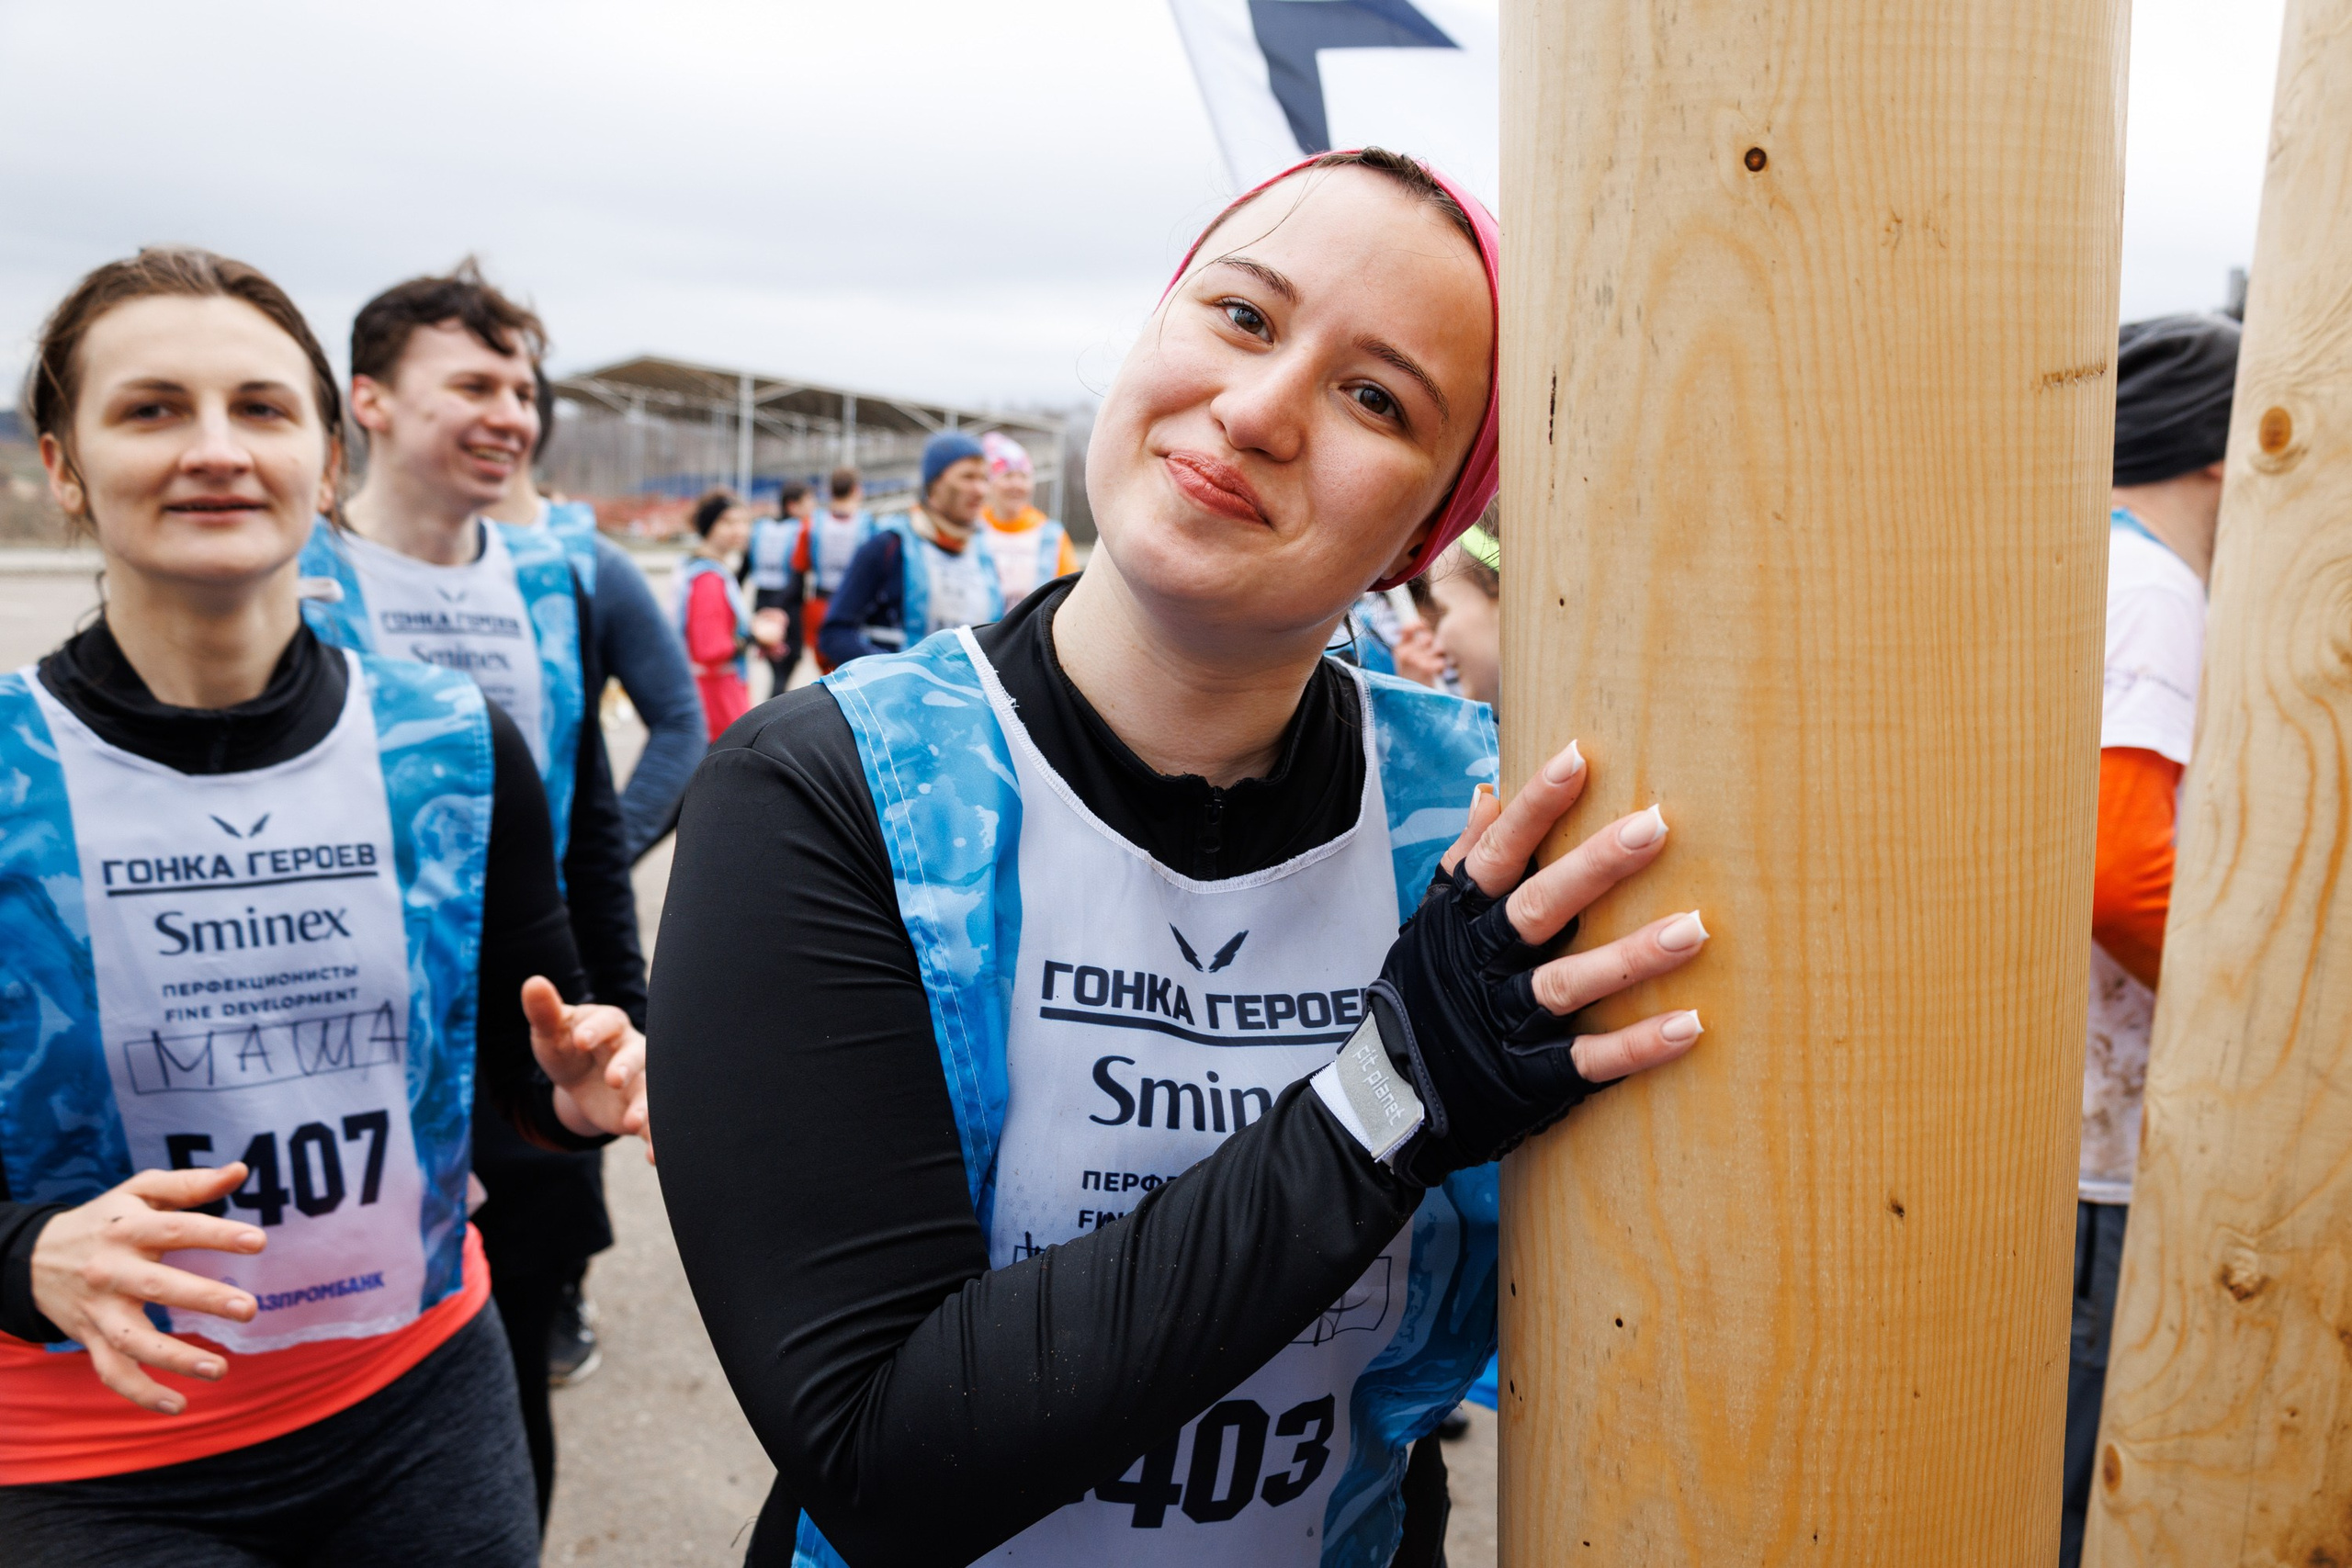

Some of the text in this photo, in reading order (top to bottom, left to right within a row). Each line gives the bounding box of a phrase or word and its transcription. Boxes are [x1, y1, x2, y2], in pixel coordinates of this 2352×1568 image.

[102, 842, 377, 886] ГОНКА ГЕРОЕВ
[154, 906, 351, 956] Sminex
[162, 965, 357, 998] ПЕРФЕКЦИОНИСТЫ
[164, 987, 358, 1022] FINE DEVELOPMENT
[1041, 960, 1367, 1030] ГОНКА ГЕРОЕ
[1089, 1055, 1272, 1133] Smin
[255, 1271, 385, 1312] АЗПРОМБАНК
[1070, 1393, 1335, 1529] 403
